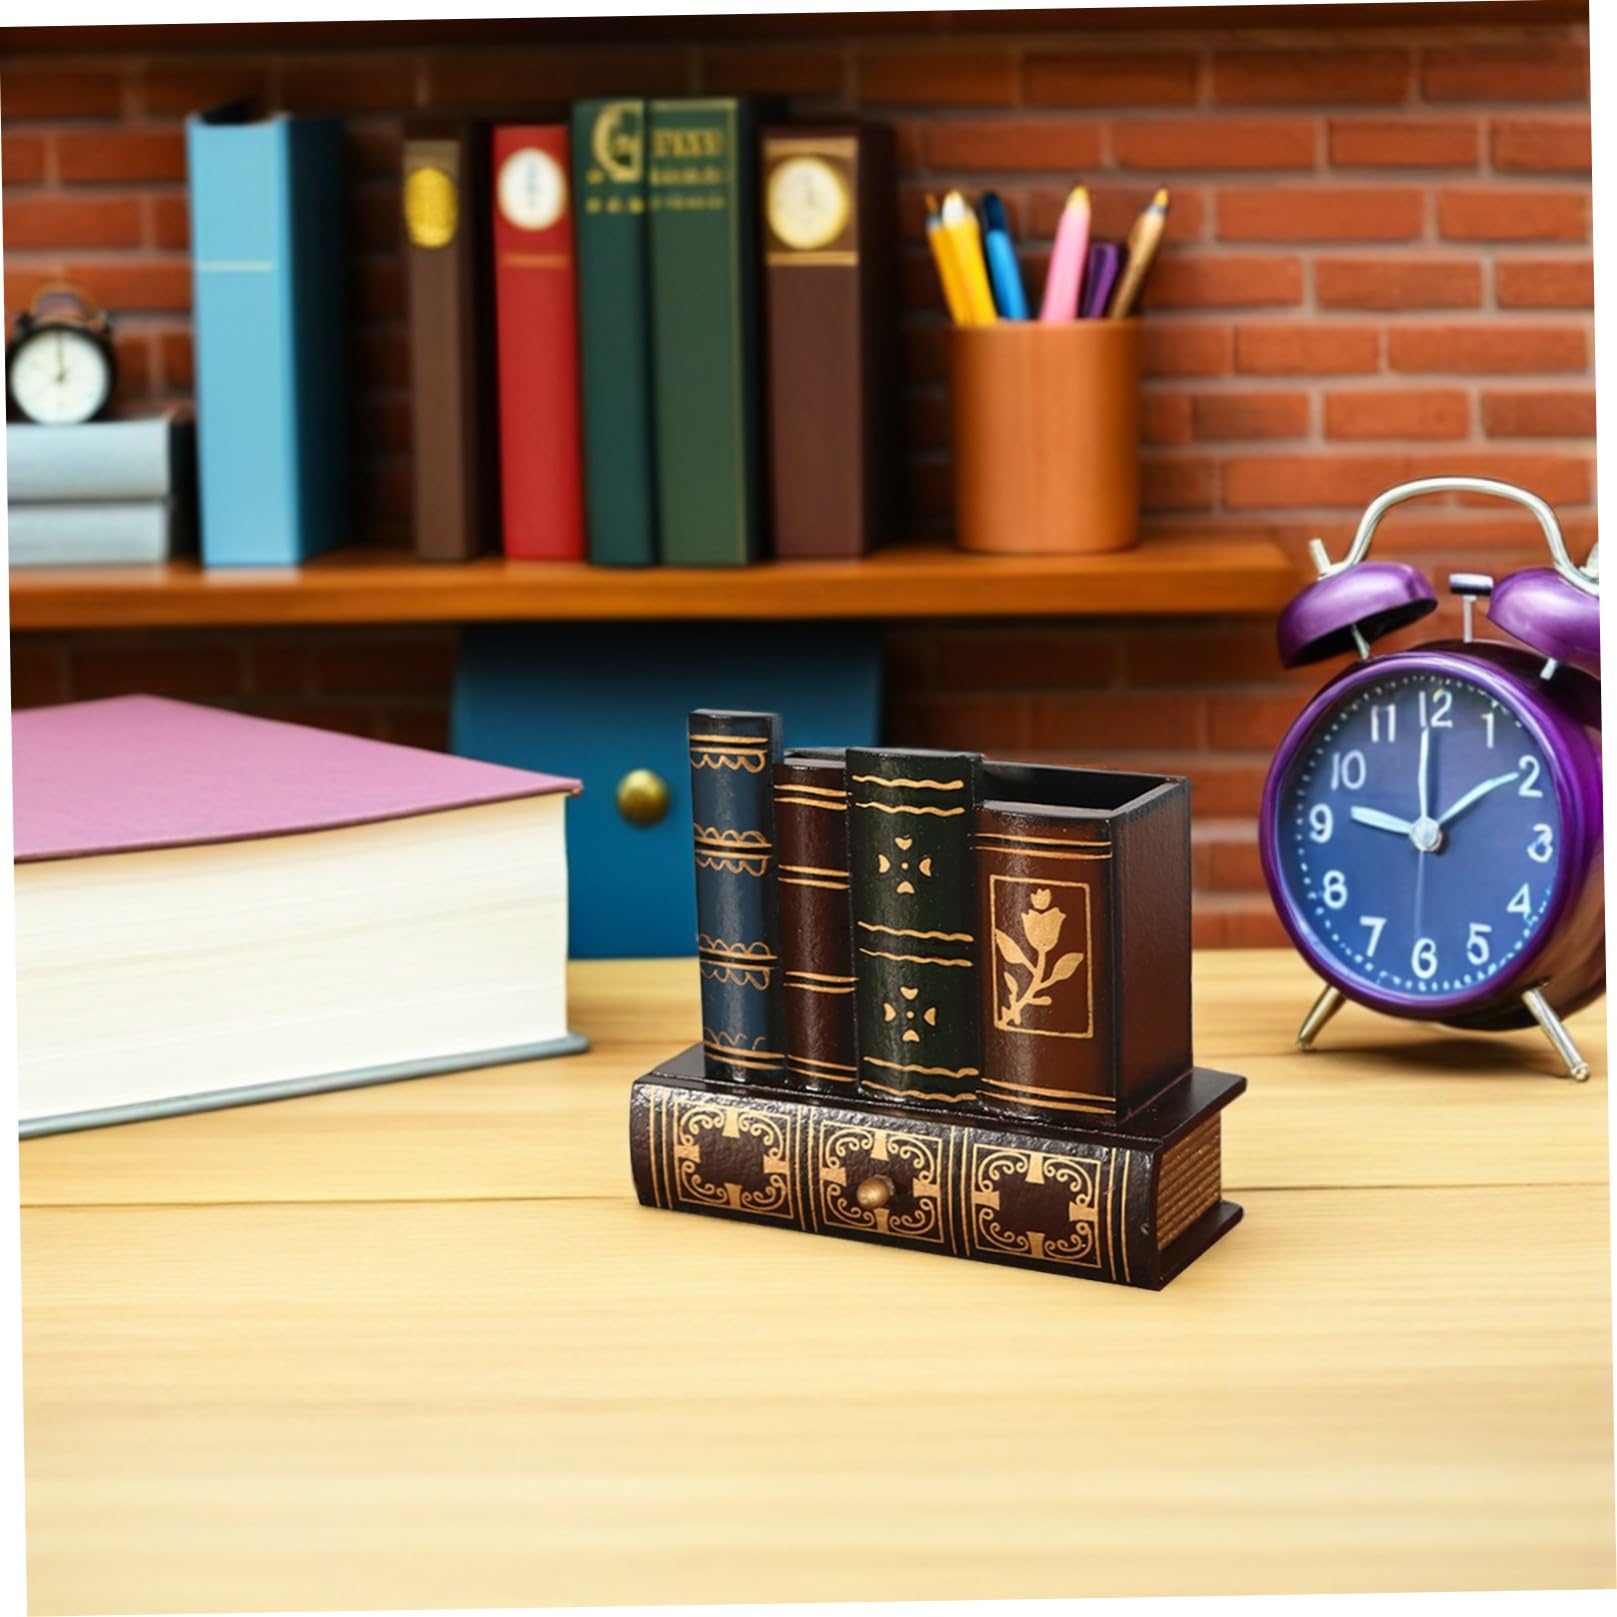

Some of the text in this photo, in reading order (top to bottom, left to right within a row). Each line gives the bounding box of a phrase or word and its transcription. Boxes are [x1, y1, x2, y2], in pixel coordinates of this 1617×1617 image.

[1370, 704, 1396, 743] 11
[1418, 688, 1454, 728] 12
[1481, 712, 1495, 749] 1
[1330, 749, 1367, 791] 10
[1517, 754, 1544, 798] 2
[1308, 802, 1334, 843] 9
[1526, 823, 1554, 863] 3
[1322, 869, 1348, 910] 8
[1506, 883, 1532, 915] 4
[1359, 915, 1387, 958] 7
[1466, 922, 1492, 965] 5
[1411, 937, 1438, 979] 6
